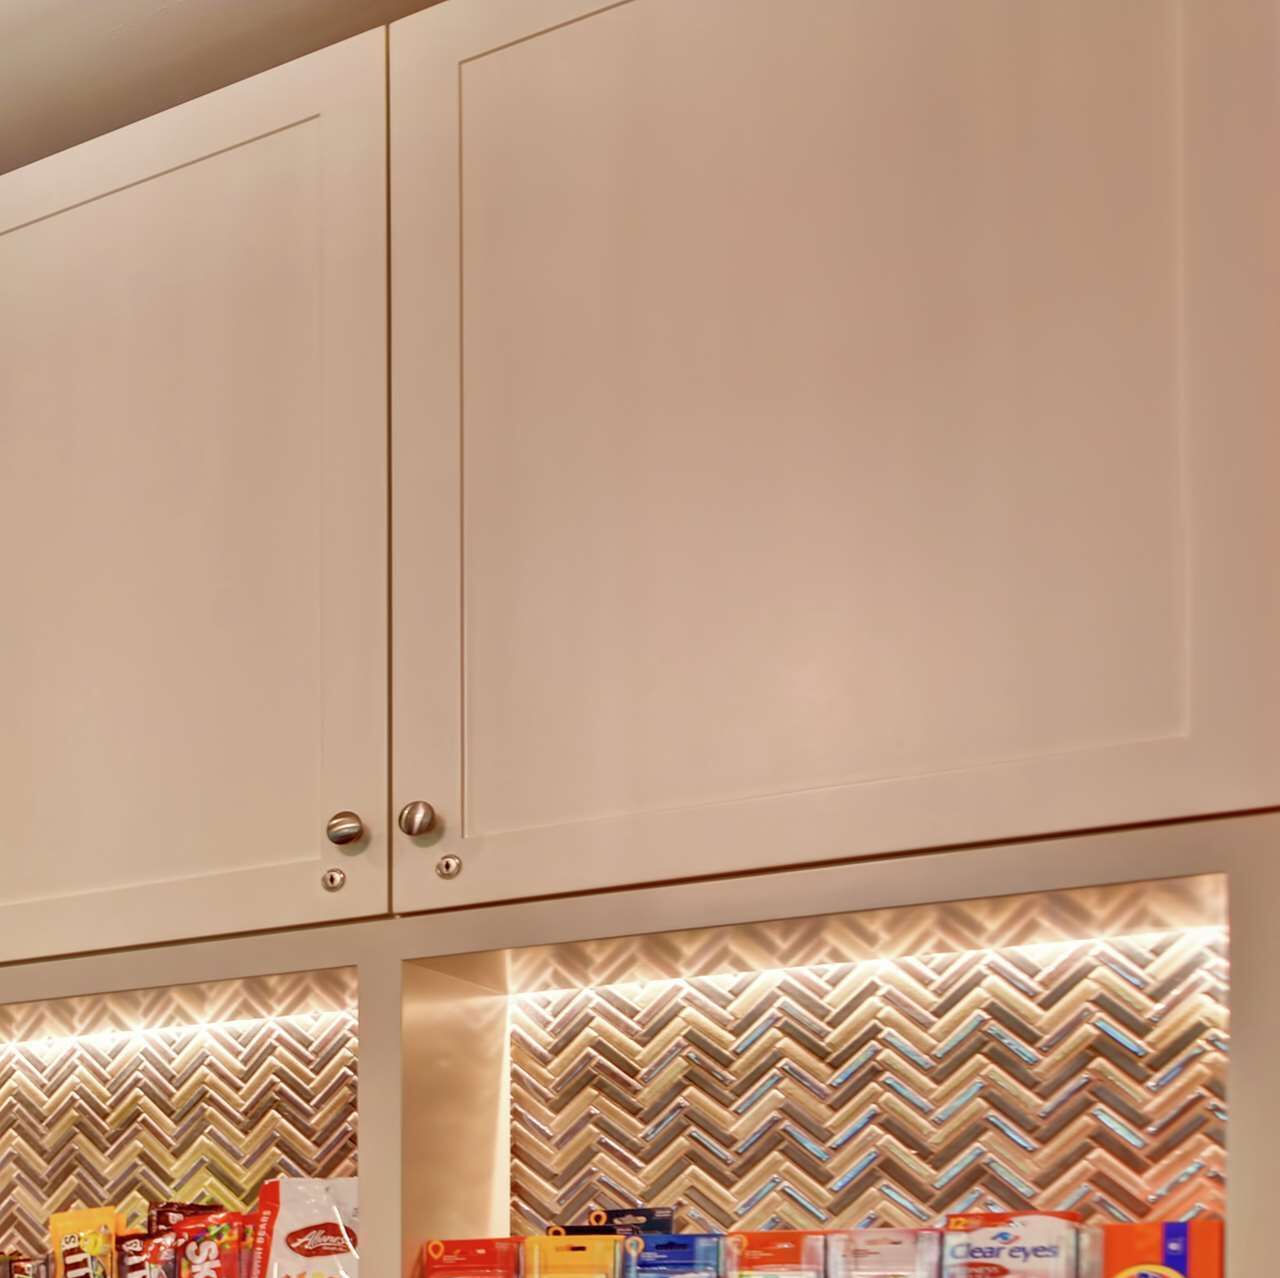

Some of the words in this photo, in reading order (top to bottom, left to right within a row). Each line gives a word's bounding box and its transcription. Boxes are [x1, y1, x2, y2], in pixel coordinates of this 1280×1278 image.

[255, 1208, 272, 1244] BEARS
[950, 1243, 1005, 1260] Clear
[1008, 1244, 1059, 1262] eyes
